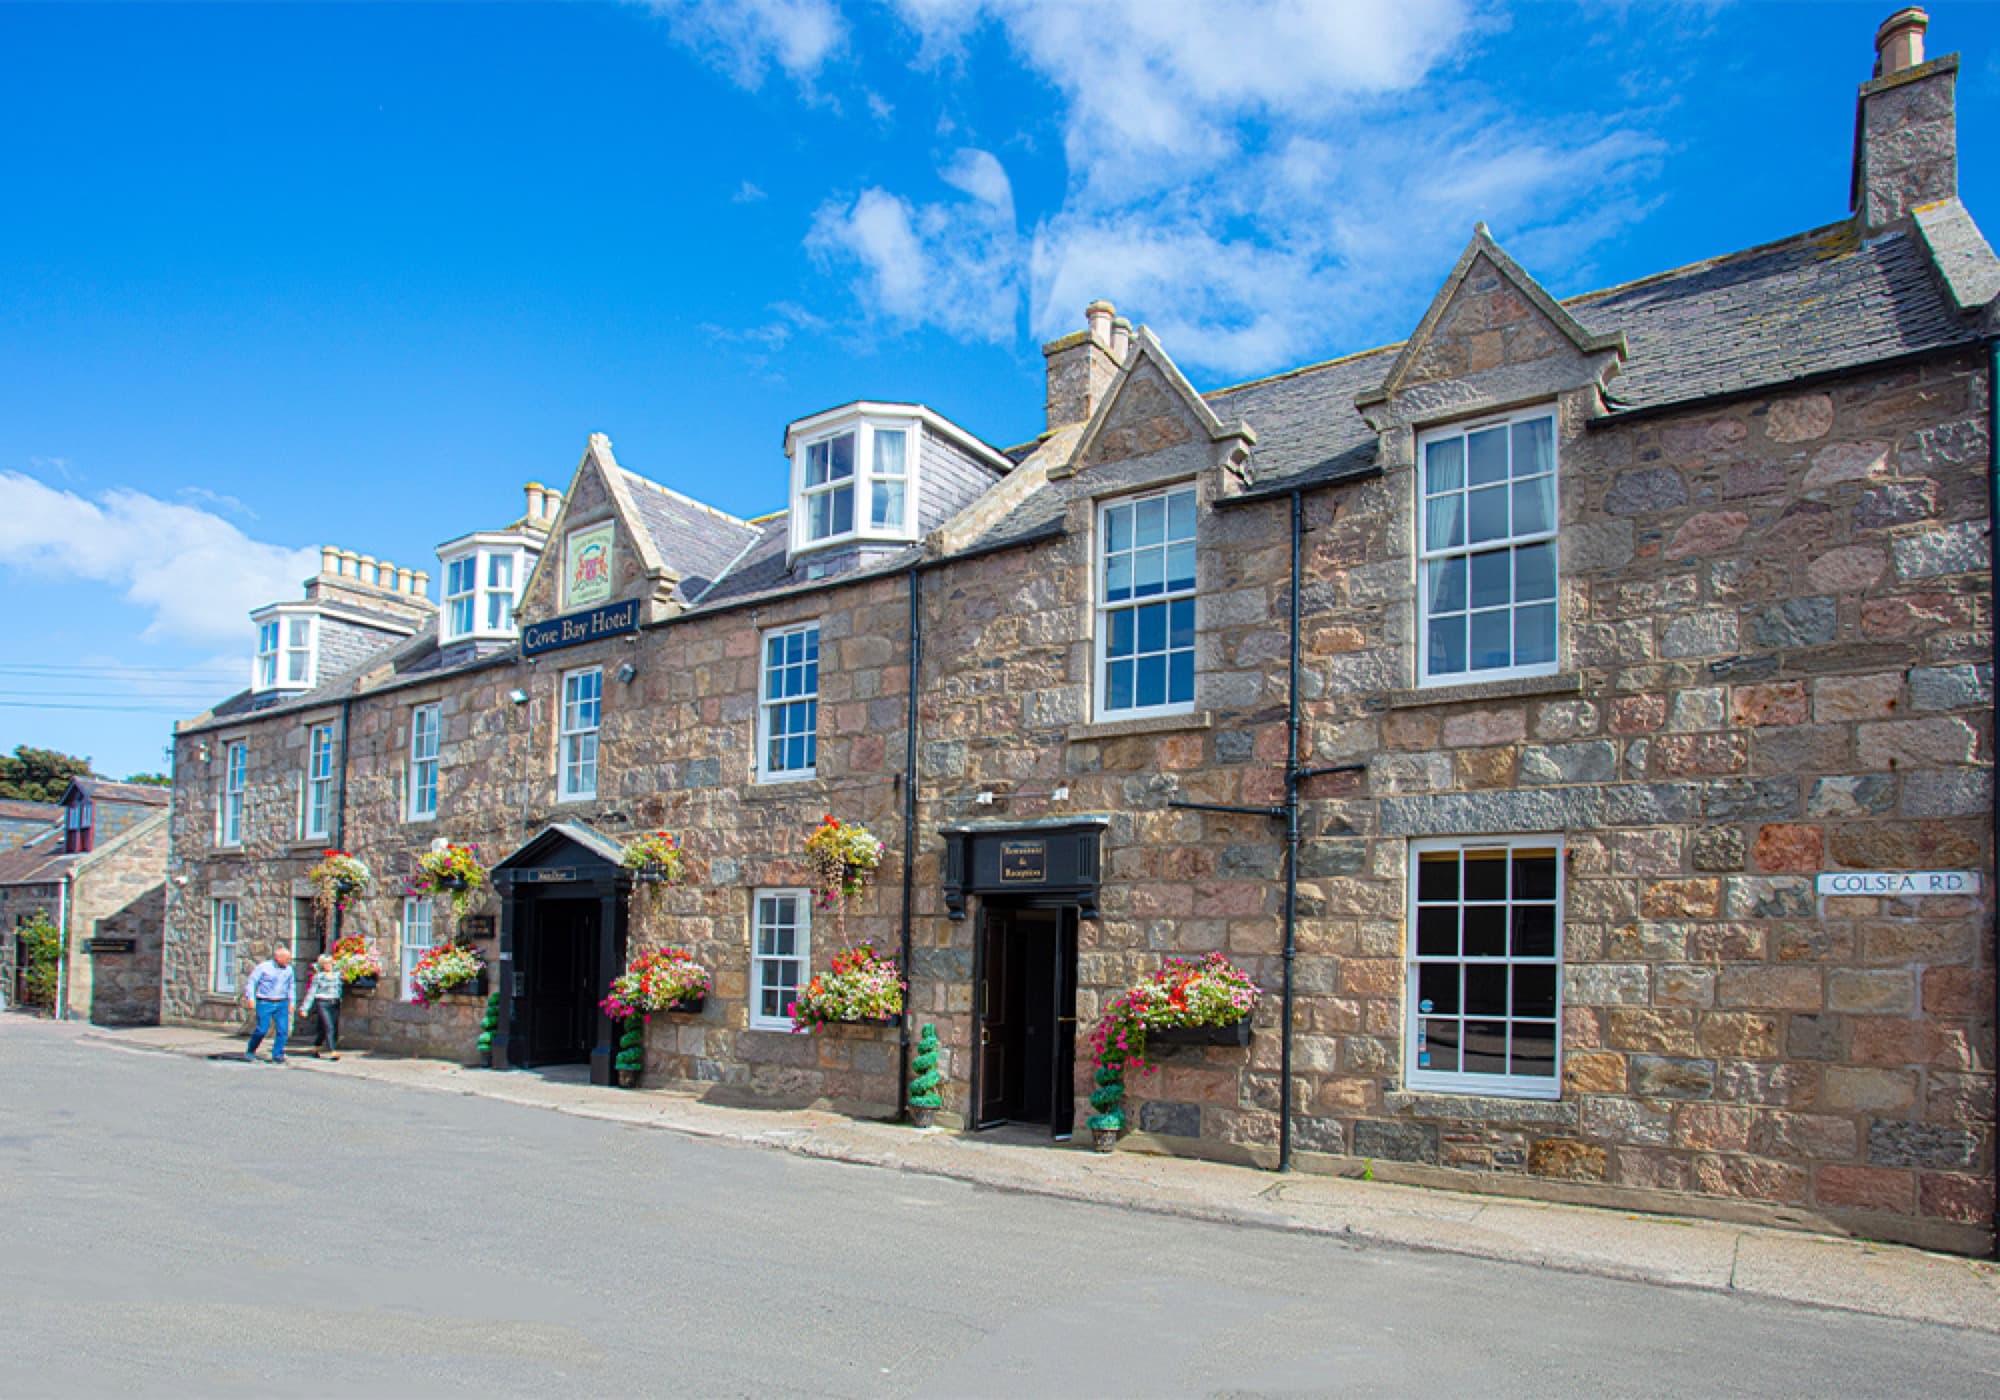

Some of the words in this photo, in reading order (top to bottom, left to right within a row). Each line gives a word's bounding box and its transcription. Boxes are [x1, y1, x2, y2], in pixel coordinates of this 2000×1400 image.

[525, 627, 558, 649] Cove
[562, 619, 588, 641] Bay
[591, 604, 632, 634] Hotel
[1832, 875, 1915, 891] COLSEA
[1929, 874, 1963, 890] RD
